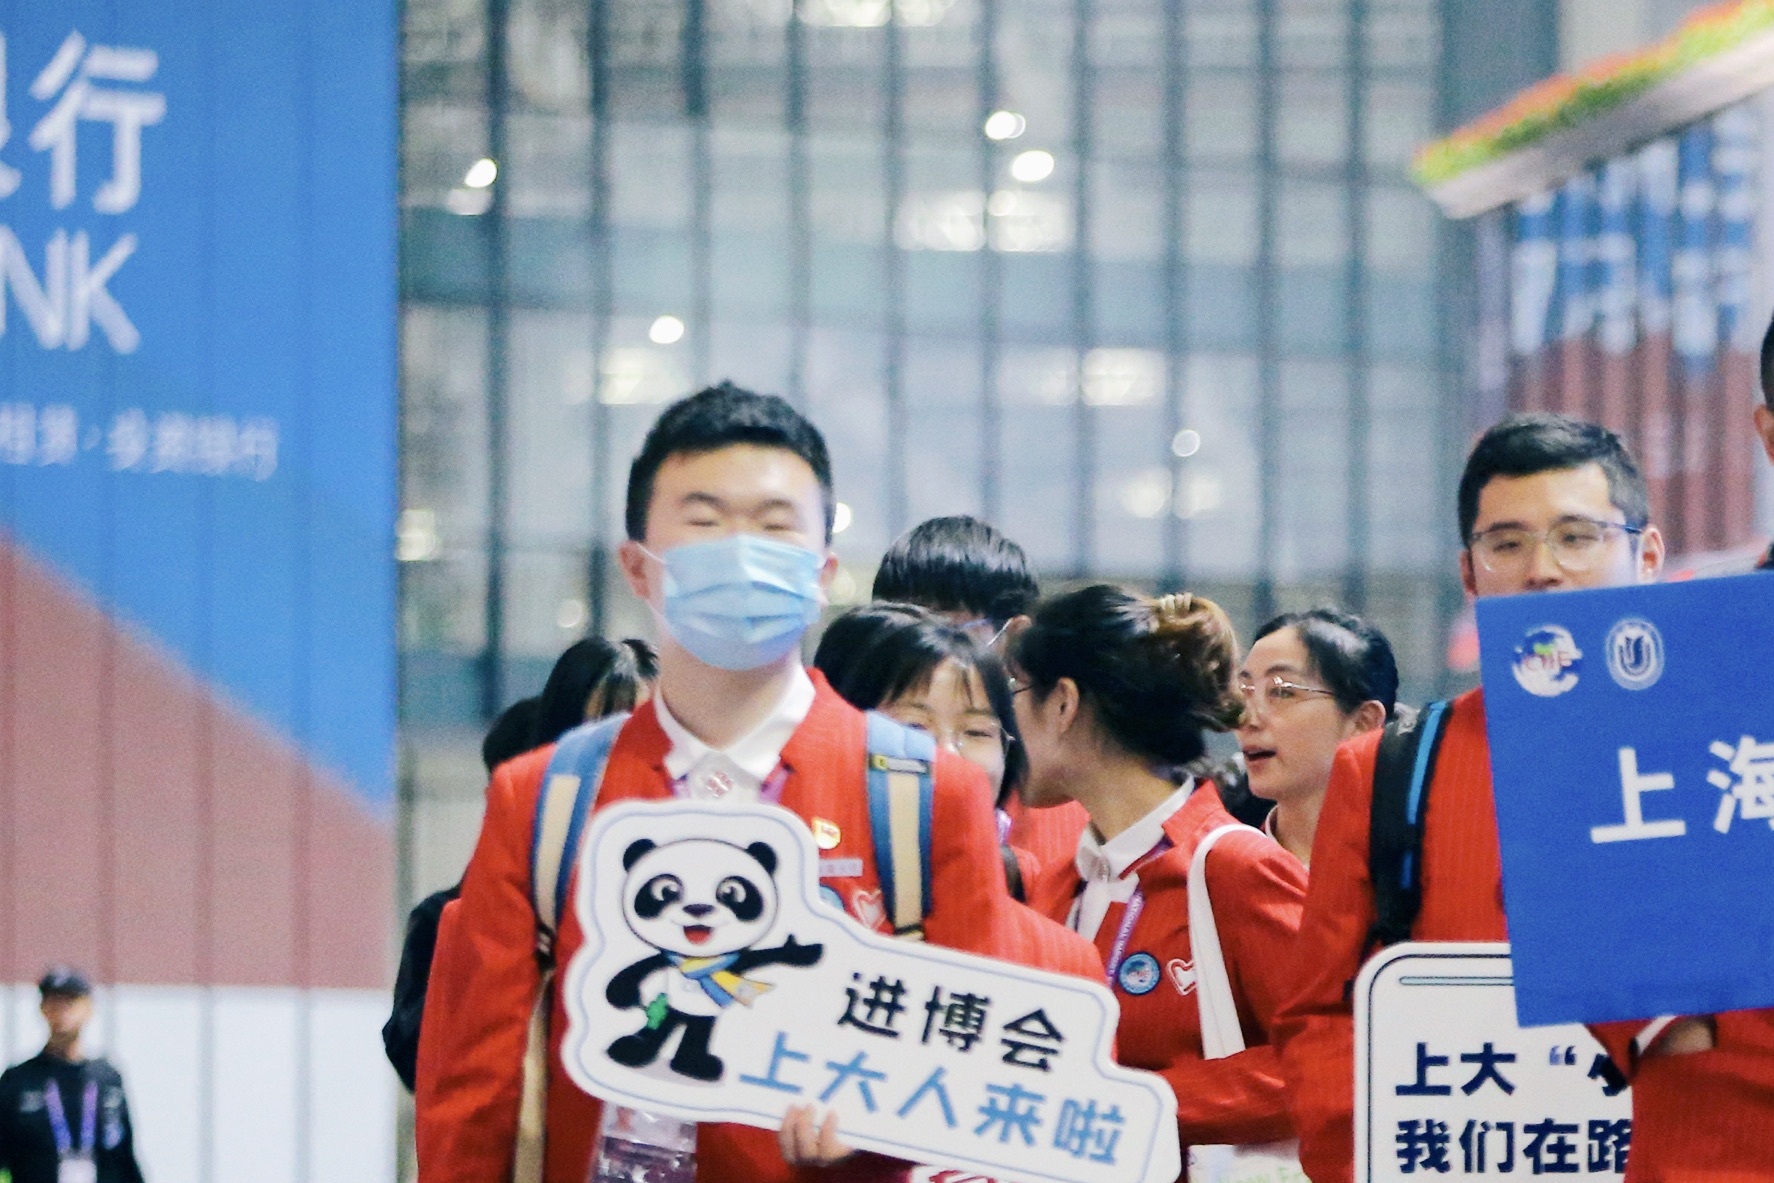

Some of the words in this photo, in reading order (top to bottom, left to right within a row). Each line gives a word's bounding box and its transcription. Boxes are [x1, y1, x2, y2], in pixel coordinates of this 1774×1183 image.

[0, 28, 167, 214] 行
[838, 971, 1065, 1072] 进博会
[740, 1031, 1127, 1166] 上大人来啦
